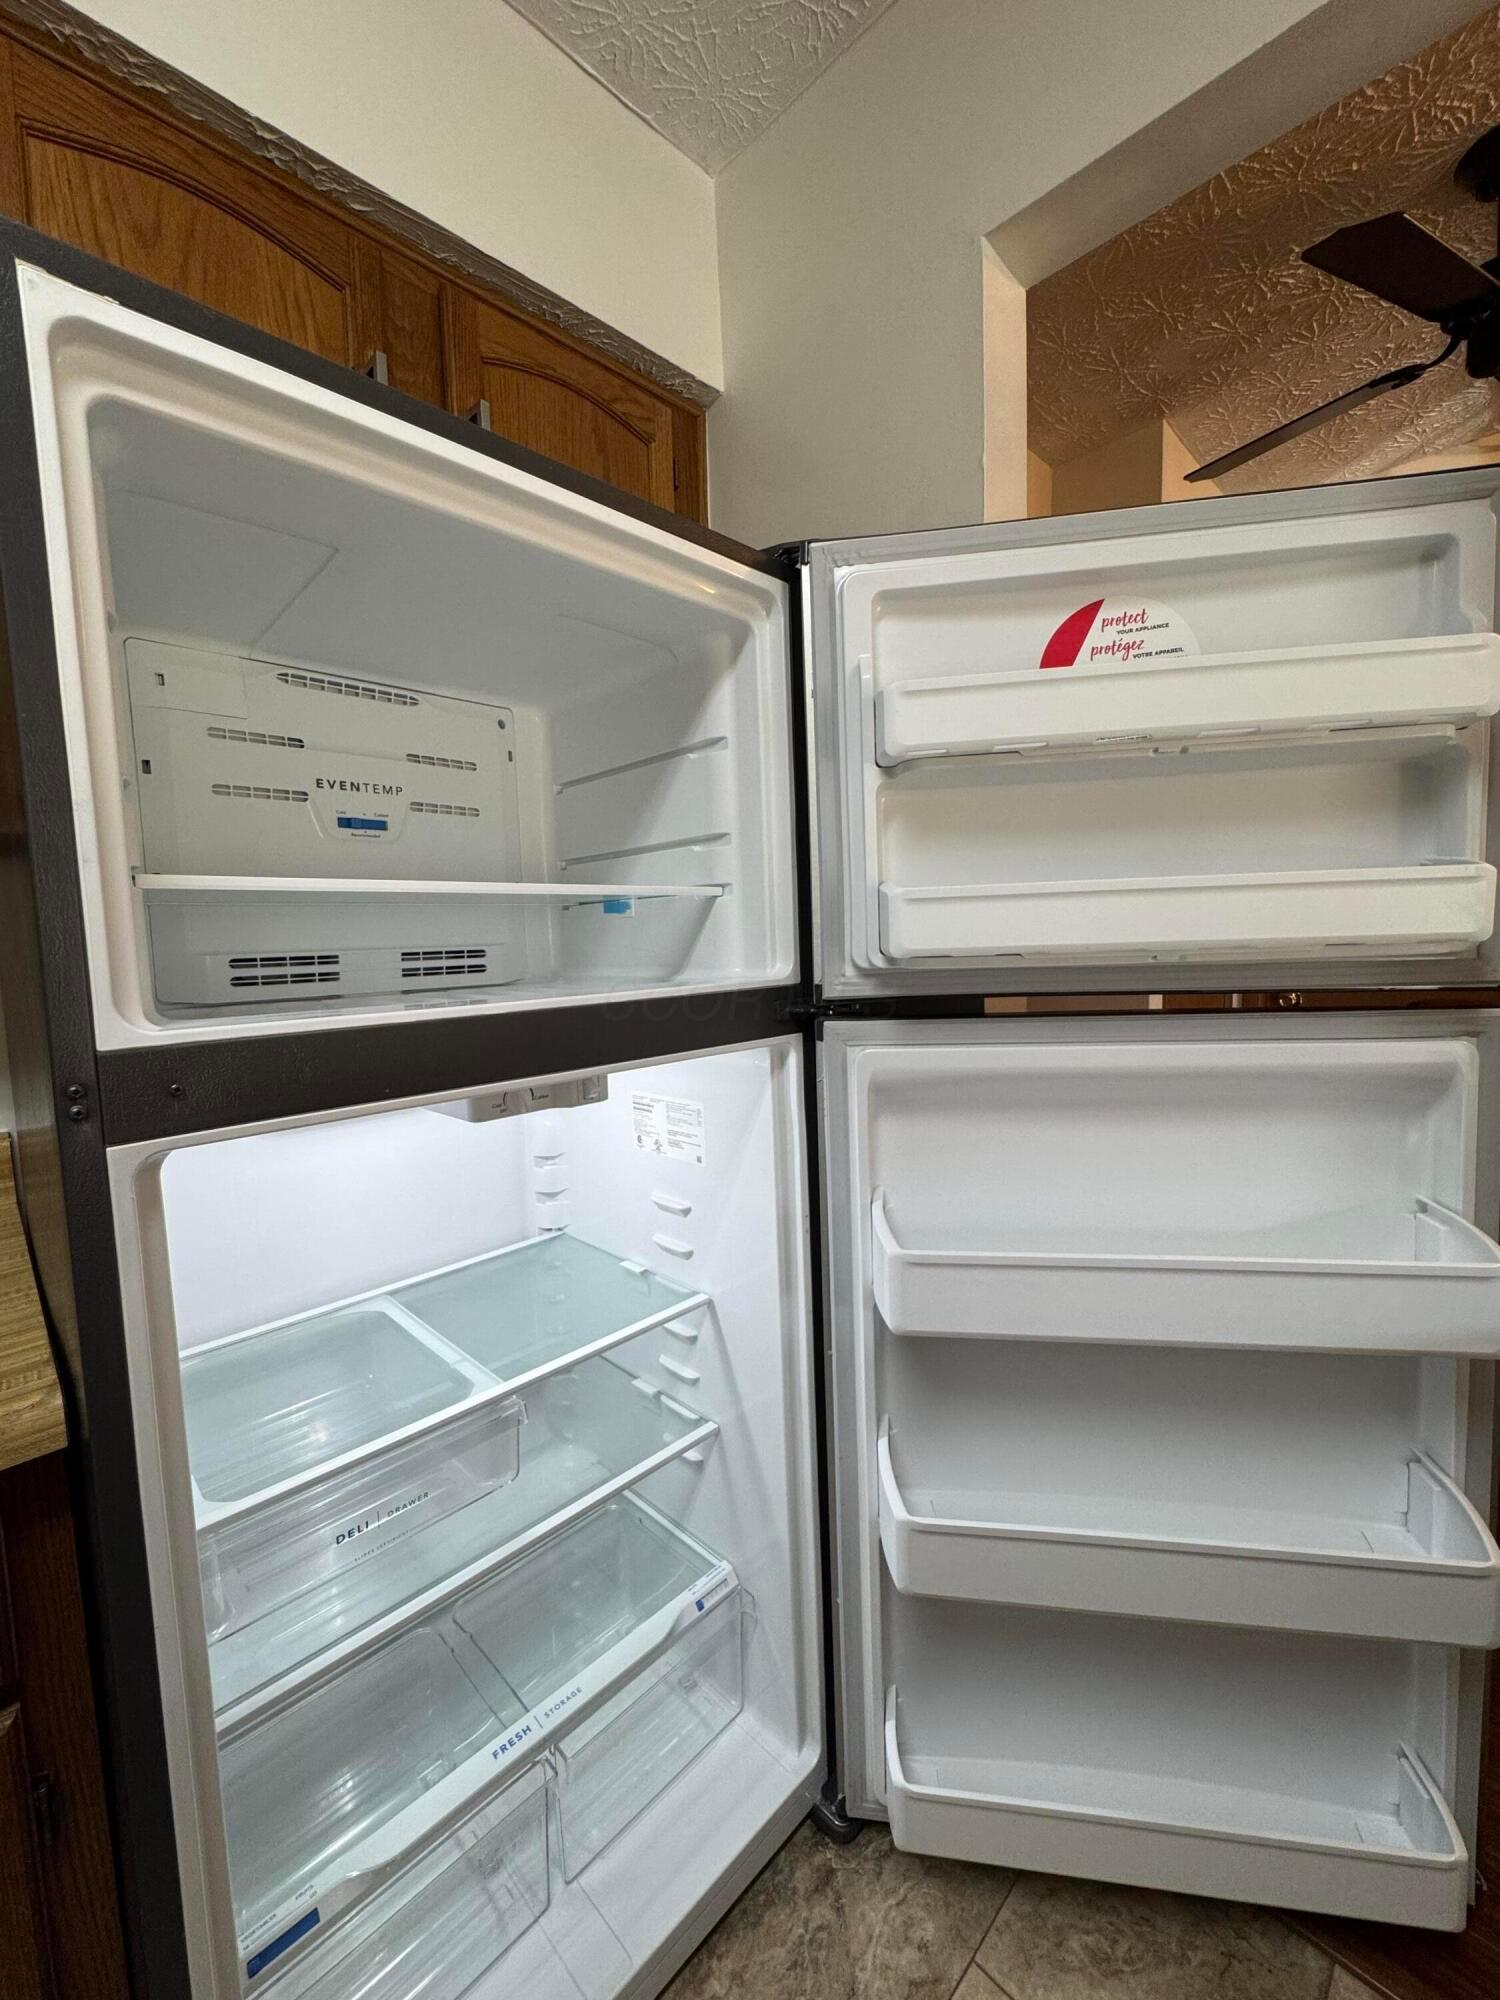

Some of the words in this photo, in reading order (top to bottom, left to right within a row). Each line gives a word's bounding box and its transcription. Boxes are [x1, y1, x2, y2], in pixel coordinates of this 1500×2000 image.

[1101, 608, 1149, 632] protect
[1135, 622, 1169, 633] APPLIANCE
[1090, 638, 1145, 661] protégez
[1132, 651, 1153, 659] VOTRE
[1154, 647, 1184, 656] APPAREIL
[316, 778, 403, 796] EVENTEMP
[336, 1520, 369, 1545] DELI
[387, 1491, 429, 1517] DRAWER
[492, 1725, 533, 1760] FRESH
[544, 1687, 583, 1719] STORAGE
